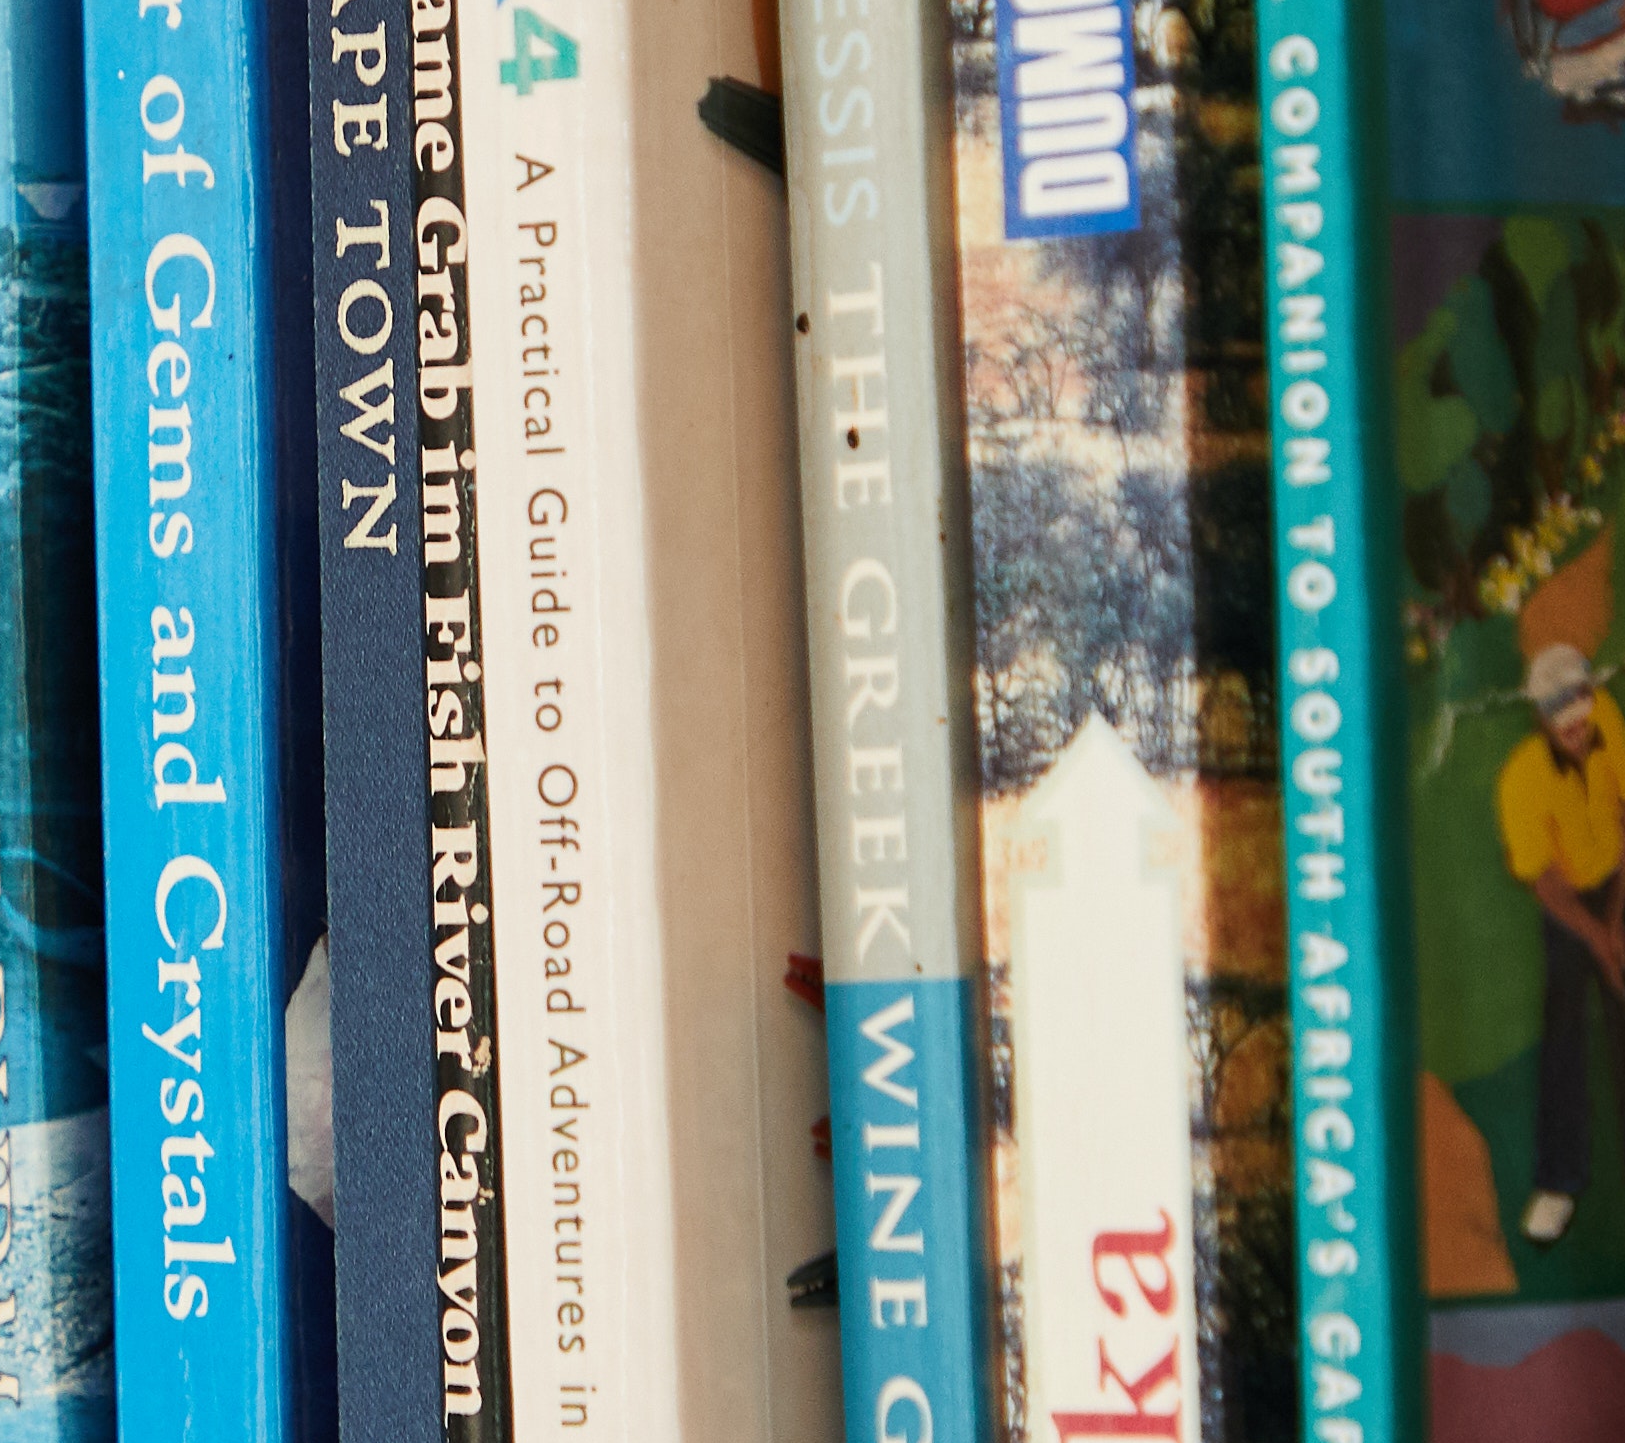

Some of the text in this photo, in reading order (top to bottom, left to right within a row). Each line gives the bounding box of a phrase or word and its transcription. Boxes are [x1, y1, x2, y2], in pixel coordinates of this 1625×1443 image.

[139, 77, 214, 190] of
[516, 154, 553, 192] A
[334, 197, 399, 556] TOWN
[416, 193, 472, 416] Grab
[518, 222, 558, 455] Practical
[828, 260, 891, 511] THE
[1269, 34, 1332, 486] COMPANION
[142, 231, 218, 559] Gems
[421, 449, 477, 577] im
[527, 486, 569, 648] Guide
[1286, 515, 1336, 613] TO
[152, 605, 227, 804] and
[425, 592, 486, 794] Fish
[531, 676, 563, 734] to
[841, 557, 911, 965] GREEK
[1290, 648, 1345, 901] SOUTH
[430, 824, 490, 1076] River
[535, 764, 580, 1016] Off-Road
[143, 853, 237, 1323] Crystals
[547, 1039, 589, 1357] Adventures
[858, 992, 927, 1330] WINE
[1300, 932, 1357, 1276] AFRICA'S
[438, 1091, 485, 1424] Canyon
[558, 1382, 597, 1430] in
